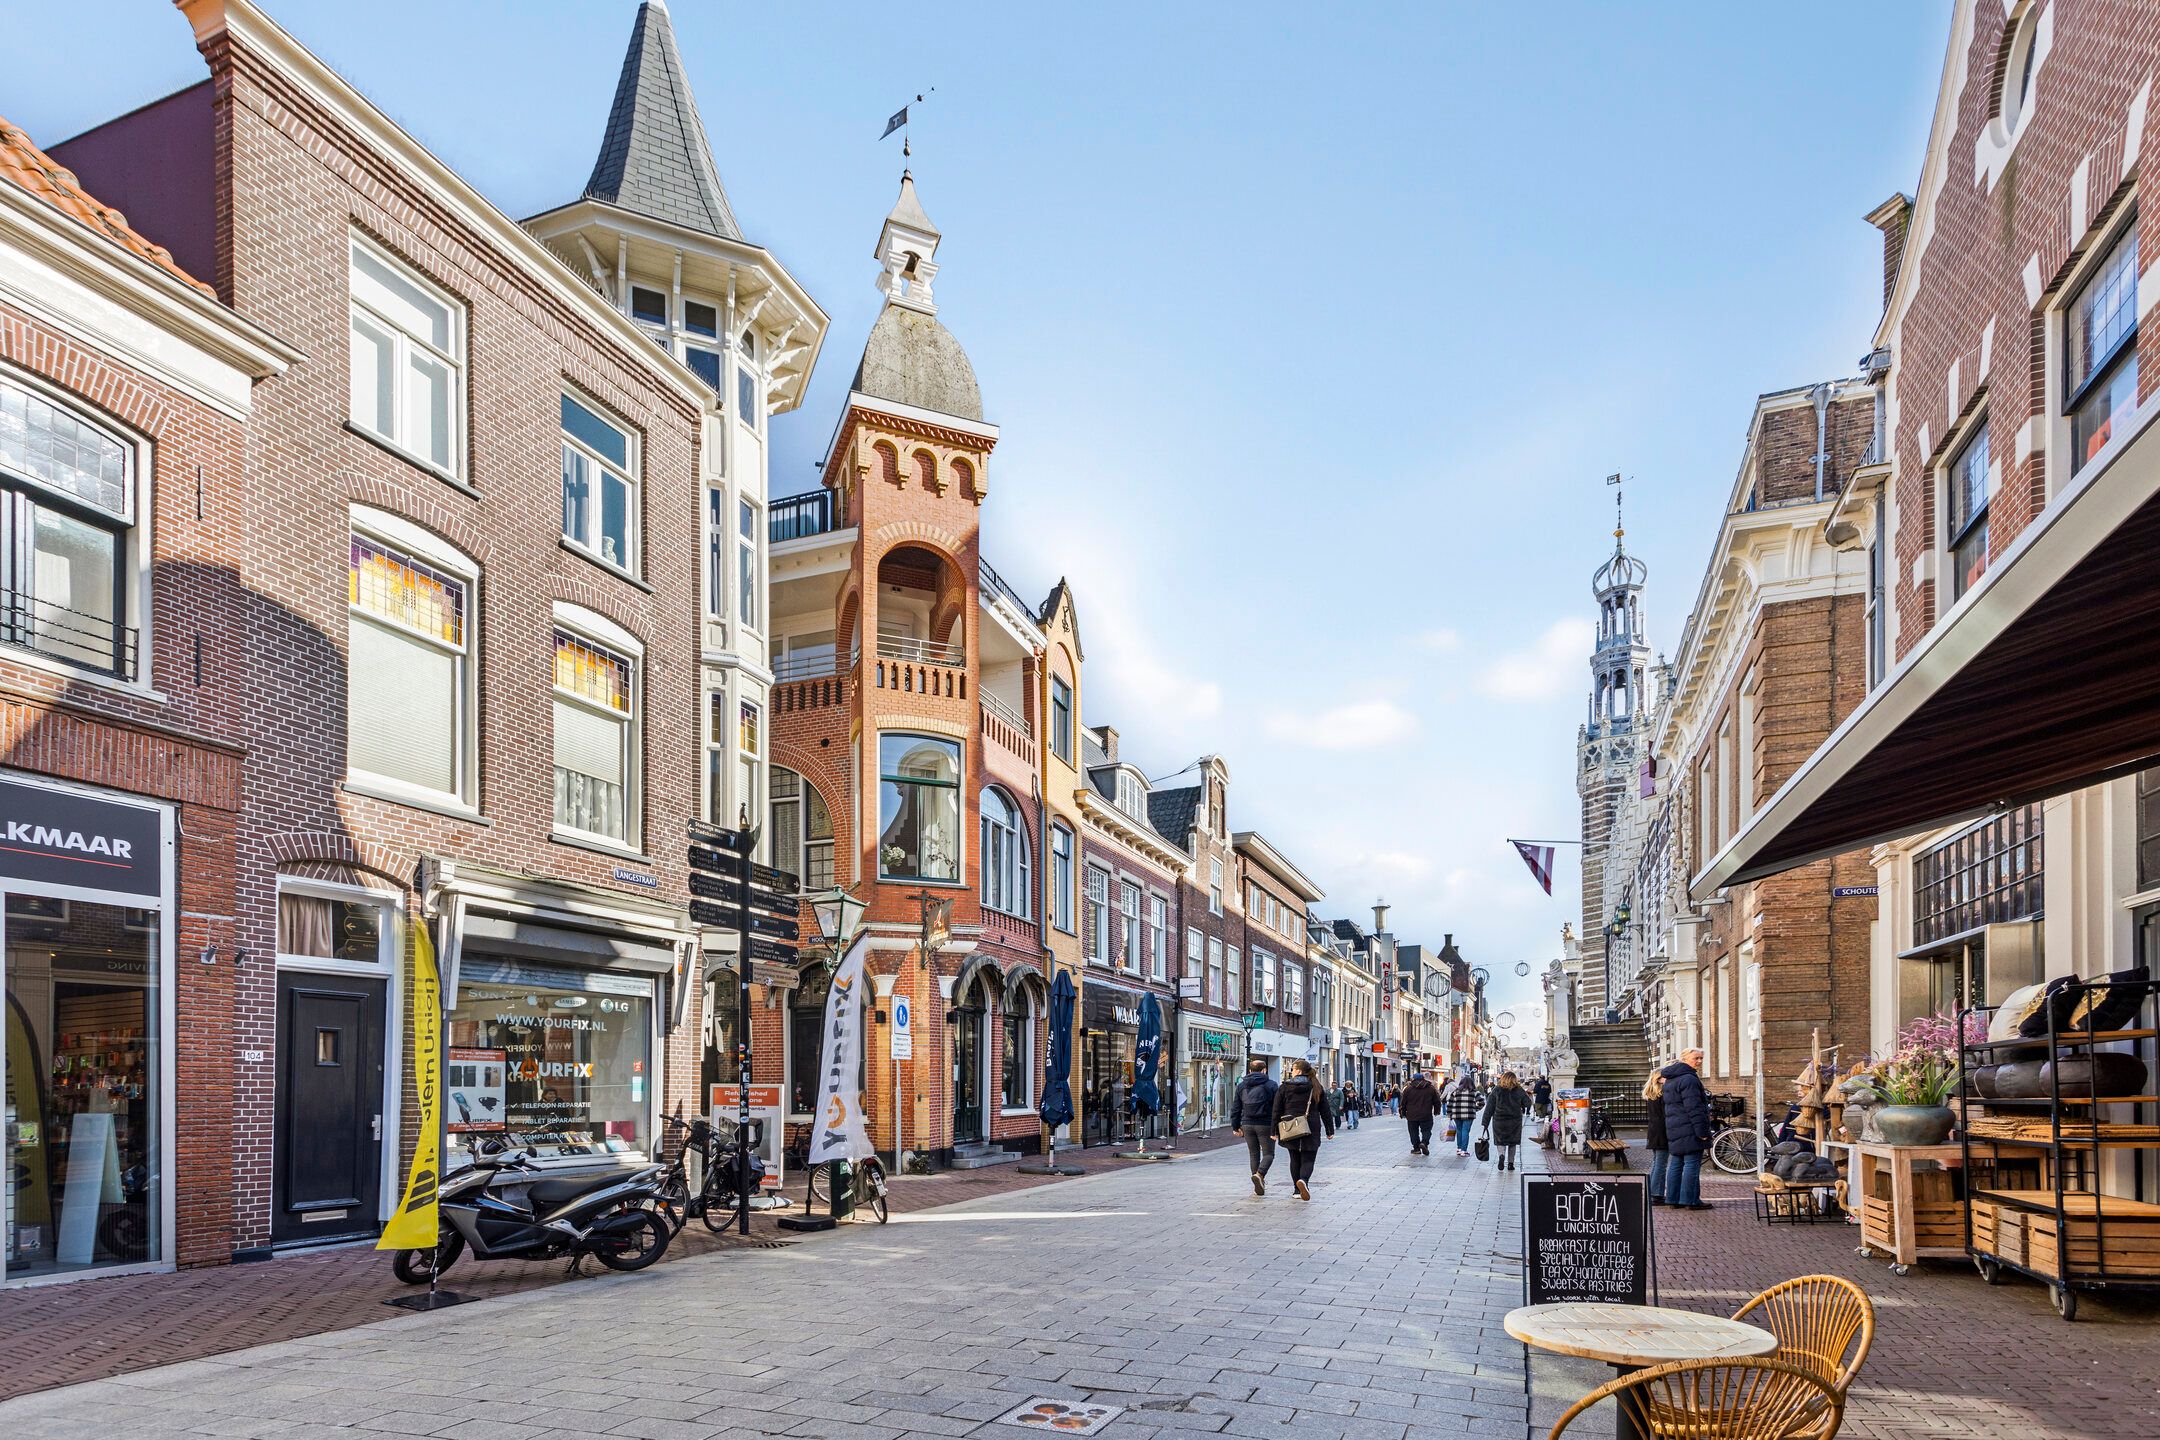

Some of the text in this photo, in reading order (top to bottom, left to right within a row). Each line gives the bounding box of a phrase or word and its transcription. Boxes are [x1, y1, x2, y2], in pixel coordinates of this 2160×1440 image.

[616, 869, 656, 886] LANGESTRAAT
[1382, 962, 1391, 1011] NELSON
[424, 977, 435, 1049] Union
[614, 1002, 629, 1013] LG
[1114, 1005, 1140, 1026] WAAR
[496, 1013, 607, 1032] WWW.YOURFIX.NL
[246, 1052, 261, 1060] 104
[1556, 1222, 1620, 1235] LUNCHSTORE
[1598, 1240, 1630, 1254] LUNCH
